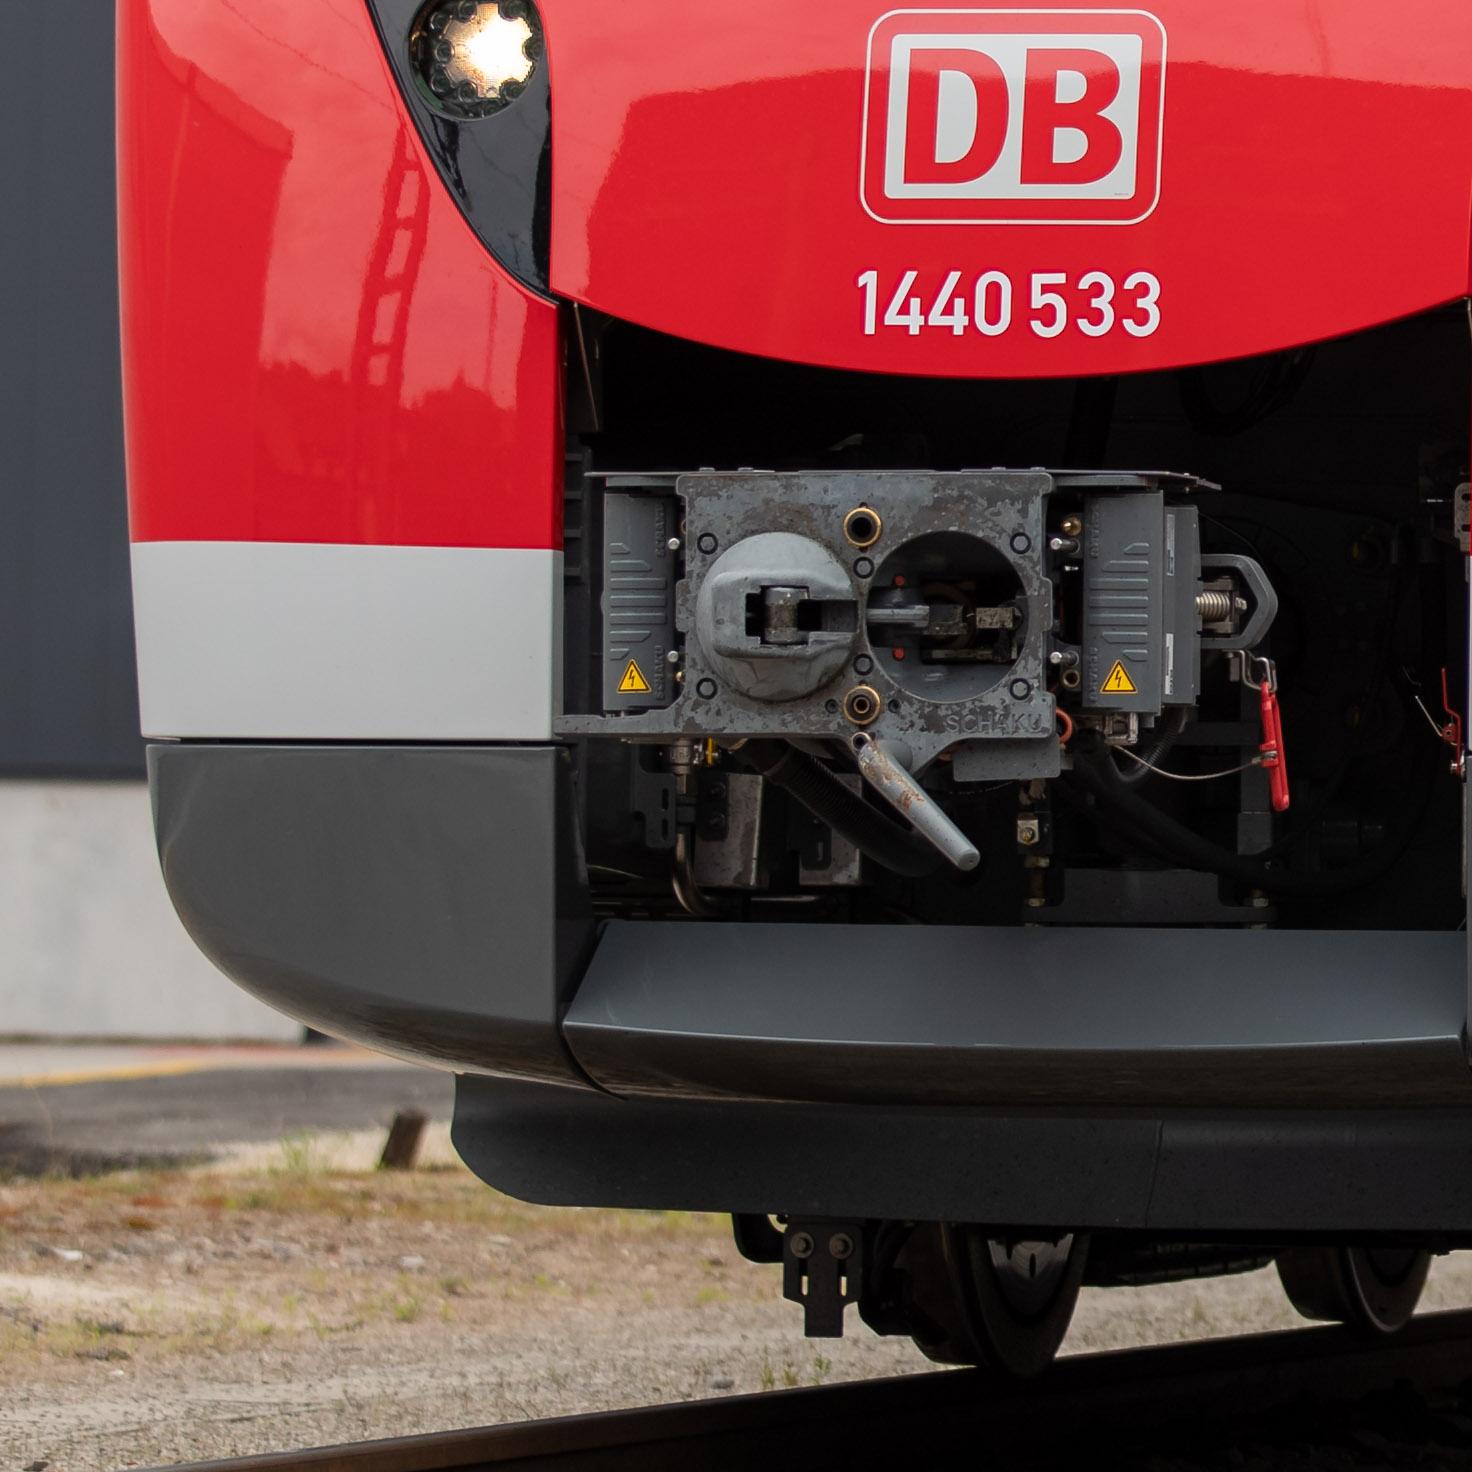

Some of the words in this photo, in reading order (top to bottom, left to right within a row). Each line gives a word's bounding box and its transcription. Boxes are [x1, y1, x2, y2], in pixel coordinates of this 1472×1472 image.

[903, 48, 1124, 185] DB
[857, 270, 1012, 336] 1440
[1030, 272, 1161, 338] 533
